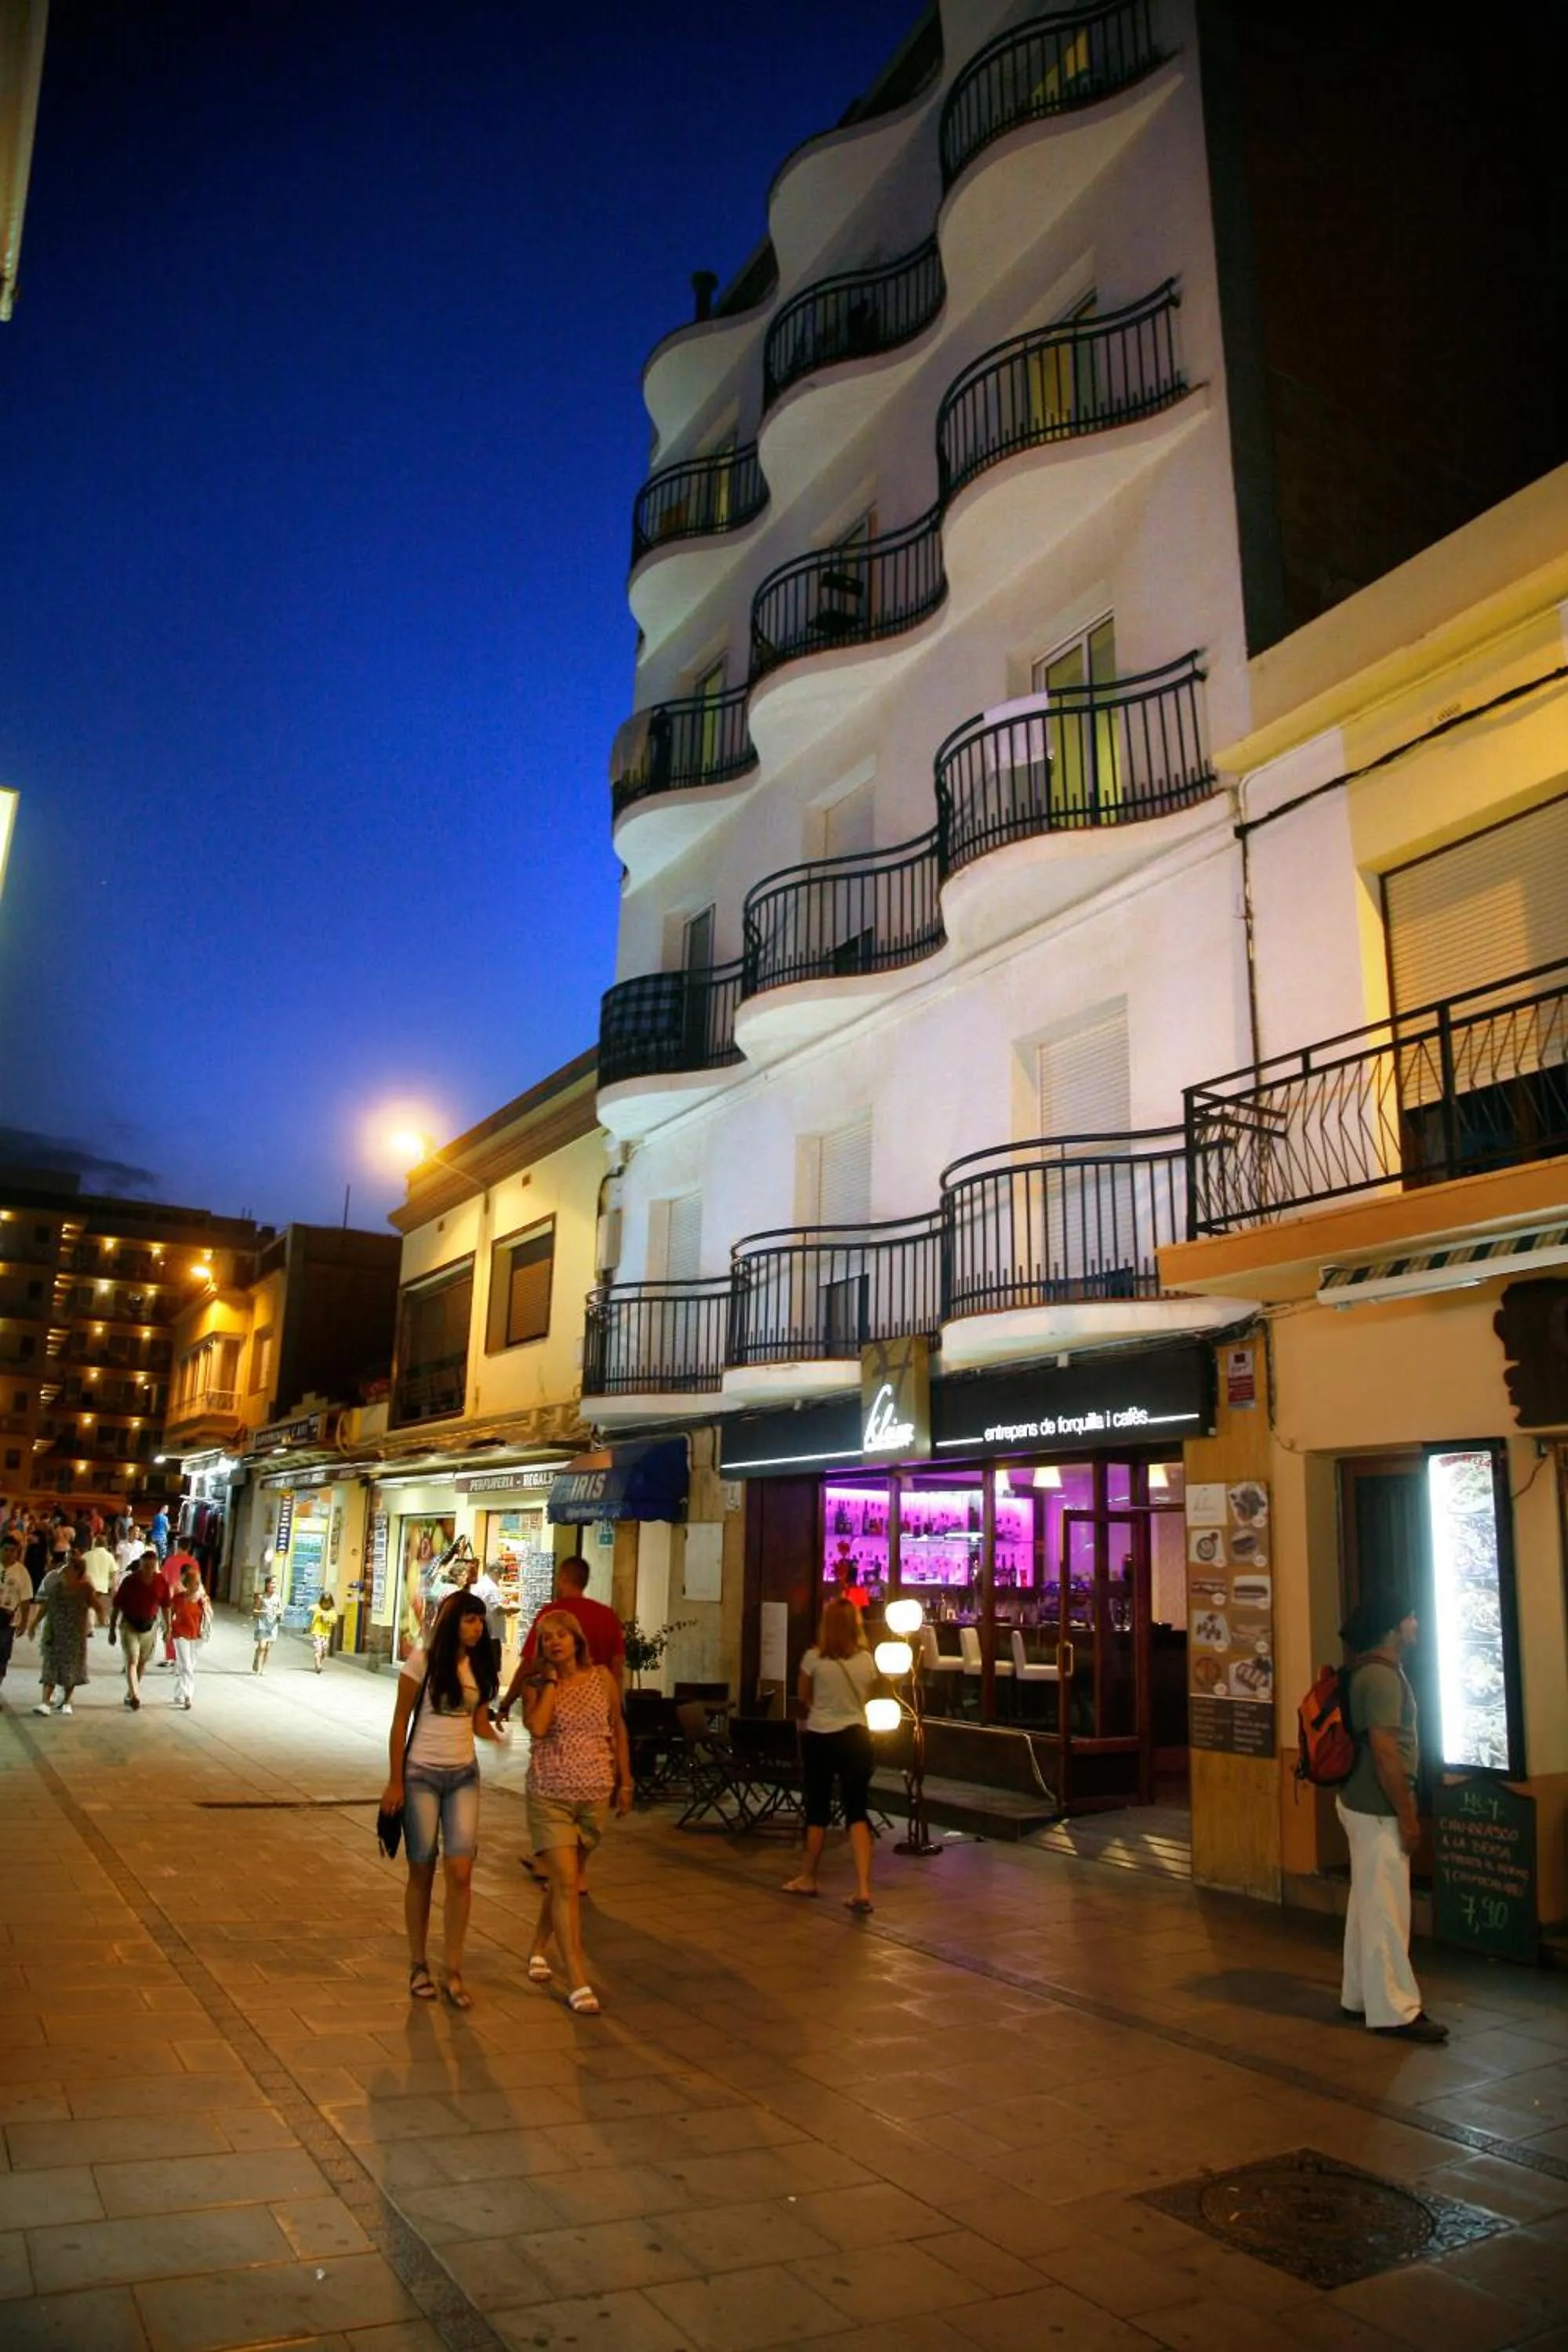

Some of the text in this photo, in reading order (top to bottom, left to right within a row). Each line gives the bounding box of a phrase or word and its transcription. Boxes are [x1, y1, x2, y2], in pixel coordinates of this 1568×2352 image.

[984, 1422, 1037, 1443] entrepans
[1040, 1417, 1056, 1436] de
[1058, 1412, 1104, 1436] forquilla
[1106, 1410, 1111, 1428] i
